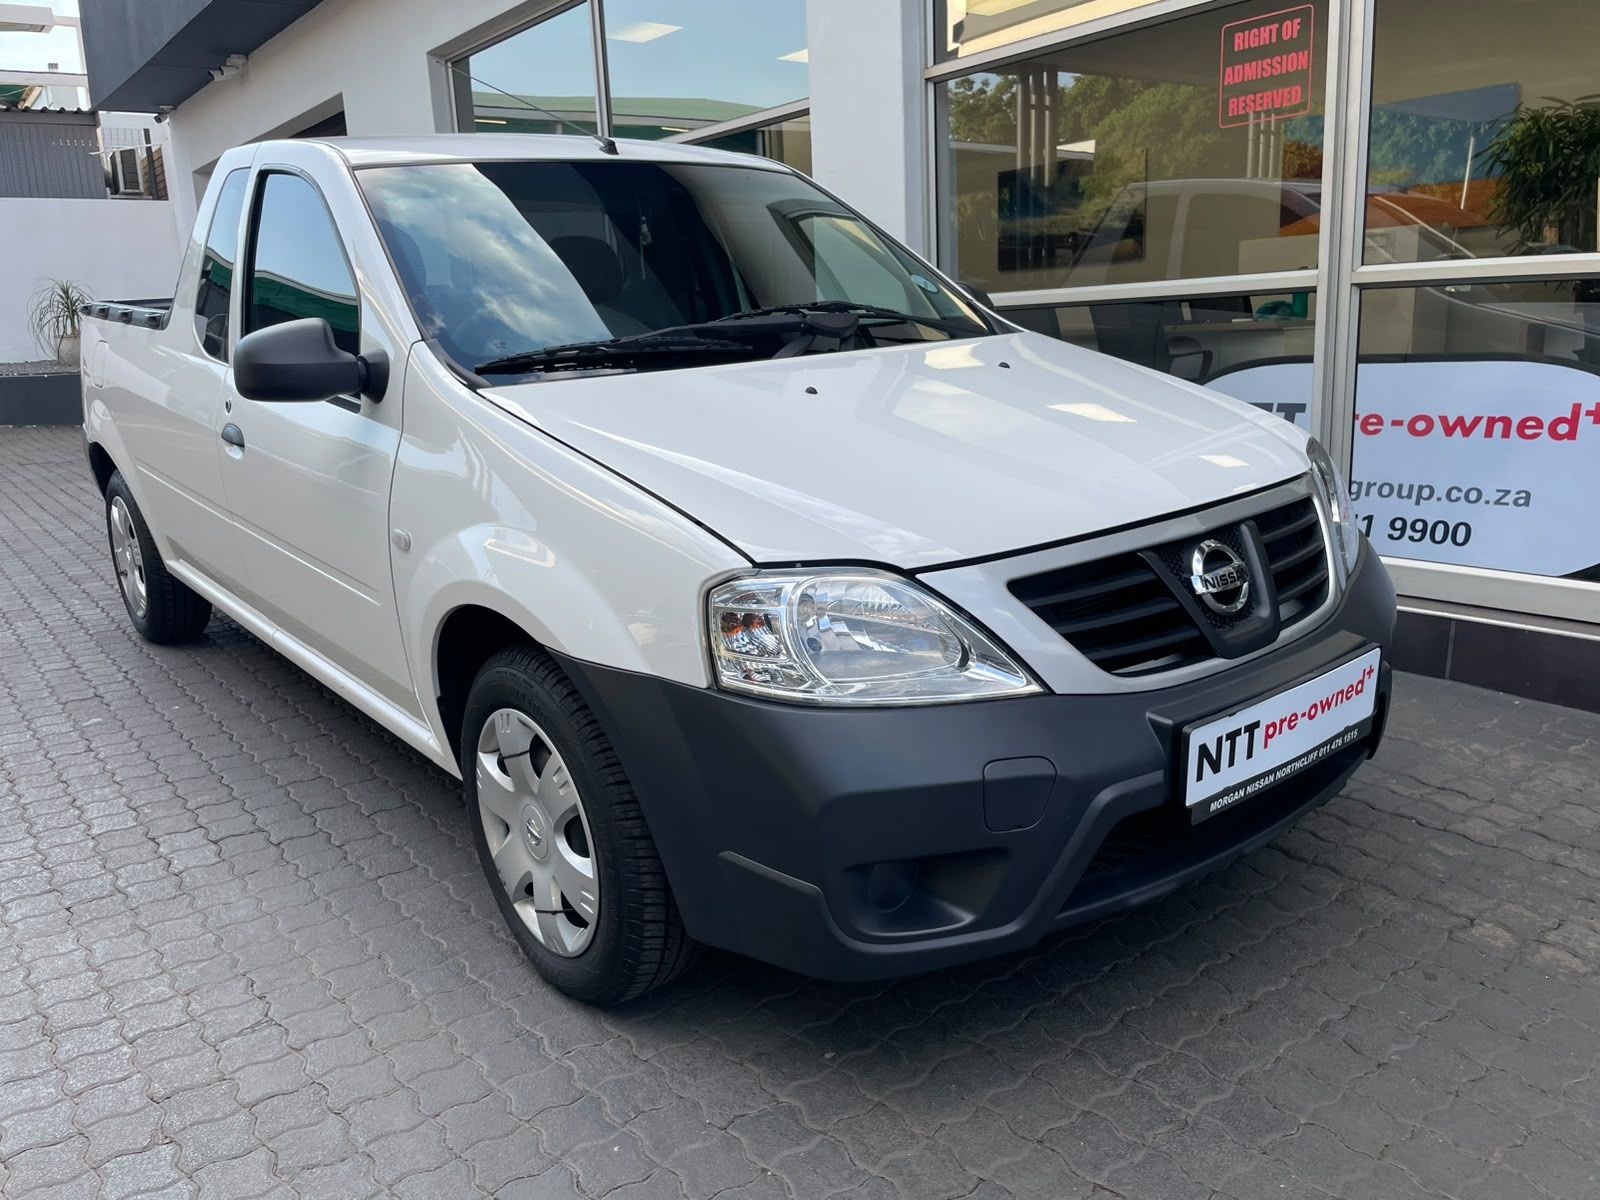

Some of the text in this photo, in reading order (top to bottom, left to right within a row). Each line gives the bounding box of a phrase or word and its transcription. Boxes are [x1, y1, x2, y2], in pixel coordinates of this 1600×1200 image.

[1234, 18, 1301, 52] RIGHT OF
[1224, 50, 1309, 86] ADMISSION
[1228, 85, 1303, 117] RESERVED
[1387, 516, 1472, 547] 9900
[1195, 720, 1261, 783] NTT
[1209, 728, 1359, 813] MORGAN NISSAN NORTHCLIFF 011 476 1515
